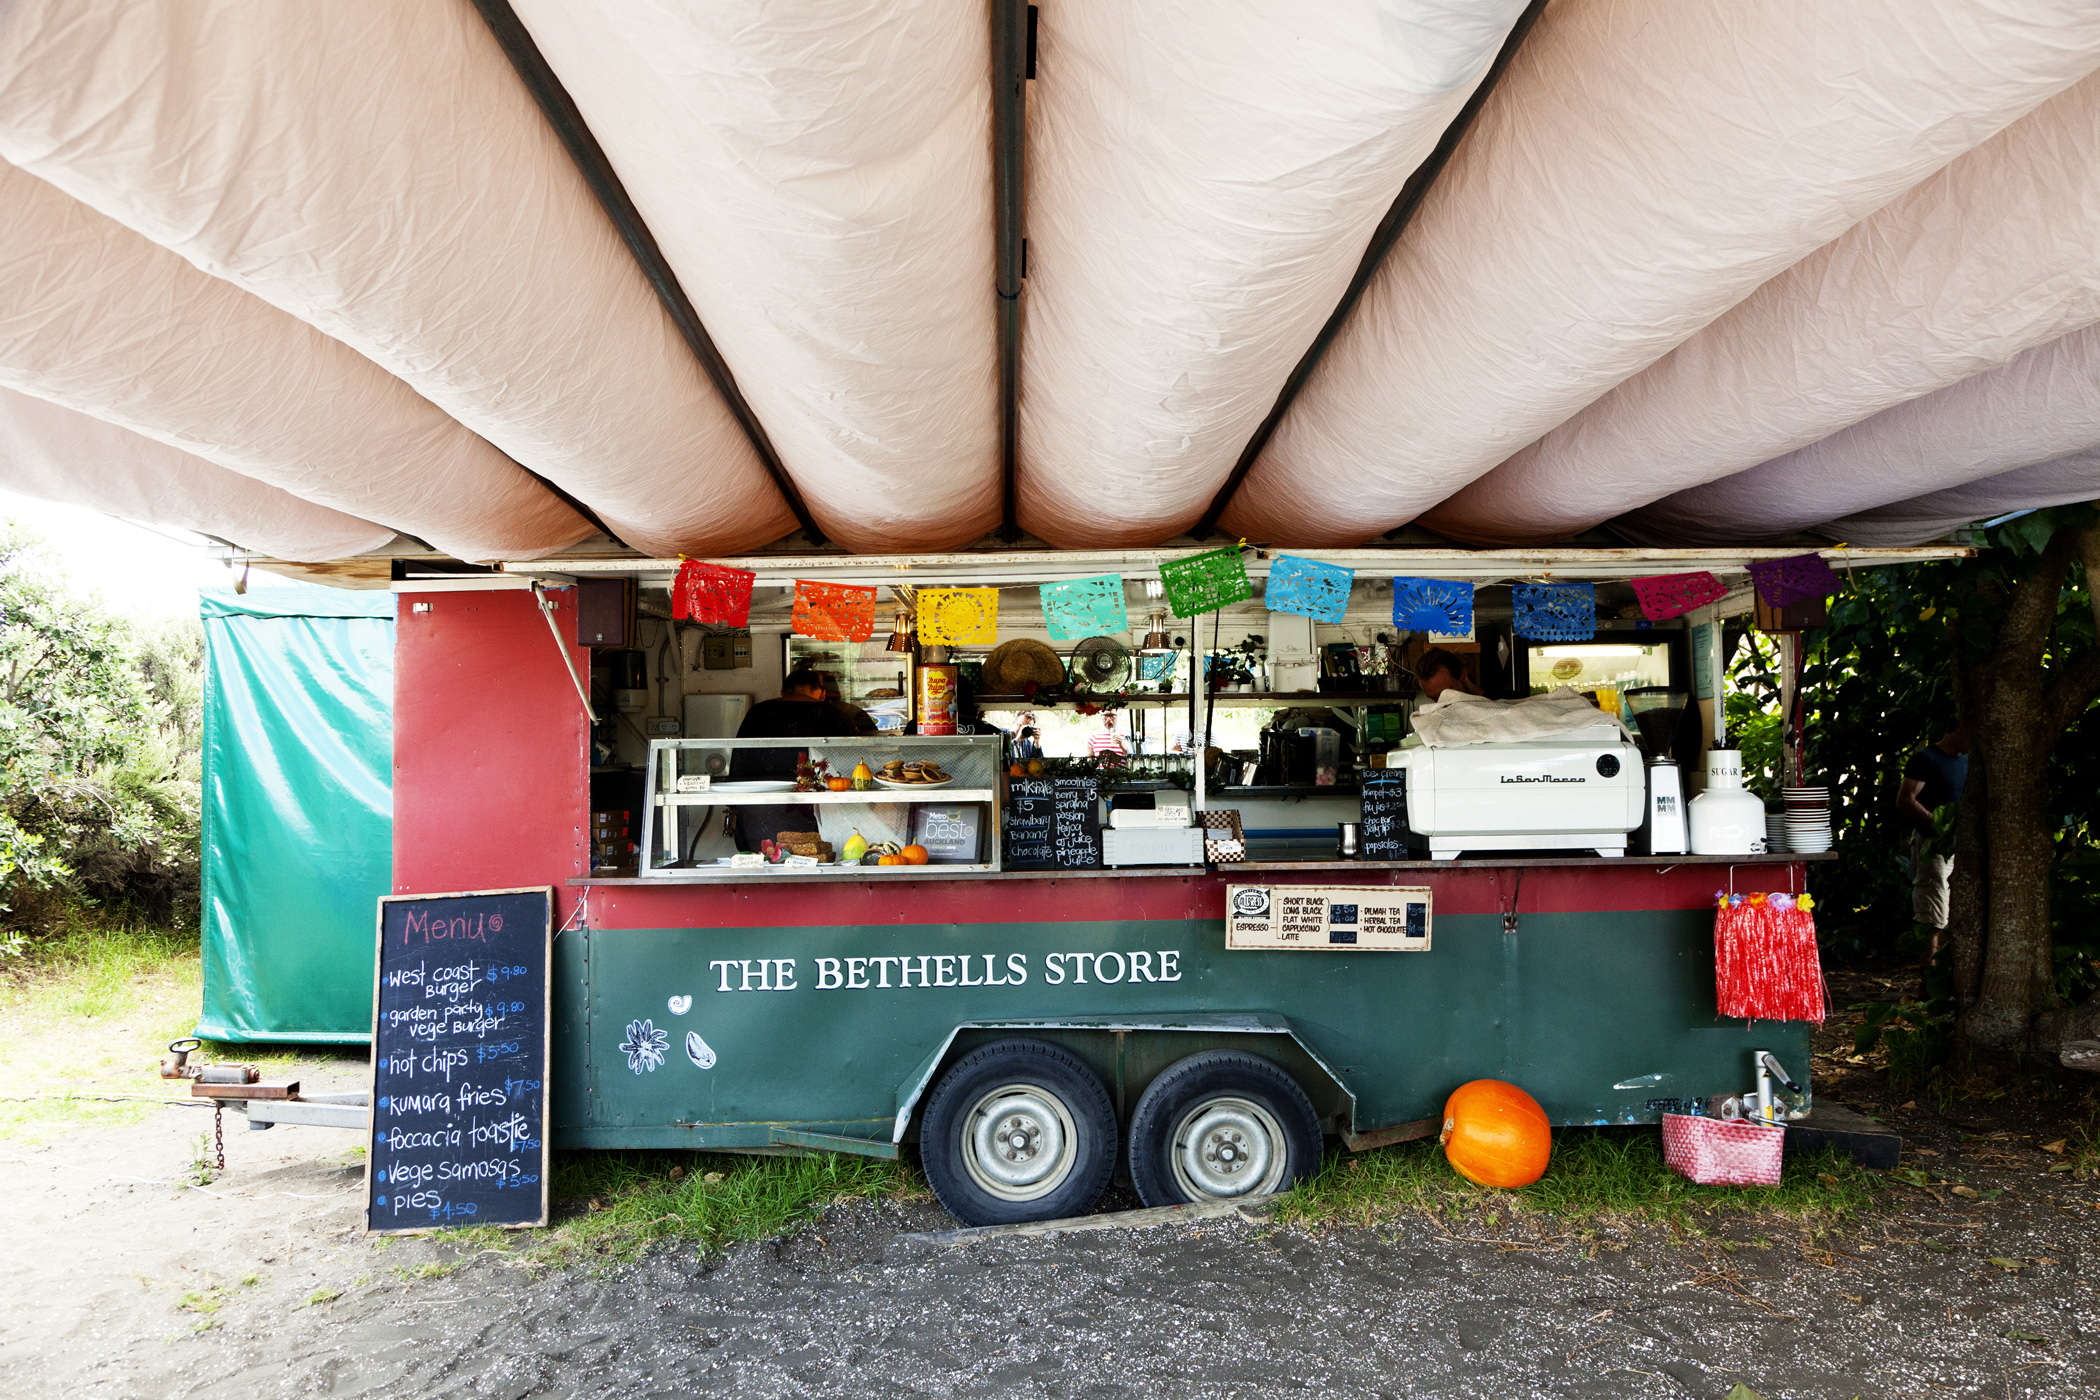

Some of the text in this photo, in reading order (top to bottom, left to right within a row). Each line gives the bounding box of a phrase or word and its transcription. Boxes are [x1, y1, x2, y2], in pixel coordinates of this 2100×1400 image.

[1711, 768, 1738, 776] SUGAR
[1055, 776, 1097, 787] smoothies
[1086, 789, 1097, 801] $5
[1017, 801, 1034, 814] $5
[929, 812, 947, 820] Metro
[925, 820, 966, 839] best
[1010, 831, 1048, 841] Banana
[924, 838, 966, 846] AUCKLAND
[1063, 855, 1096, 866] juice
[1283, 897, 1304, 905] SHORT
[1283, 907, 1322, 915] LONG BLACK
[1364, 907, 1387, 915] DILMAH
[1389, 907, 1400, 915] TEA
[1283, 916, 1323, 924] FLAT WHITE
[404, 910, 486, 945] Menu
[1236, 923, 1269, 932] ESPRESSO
[1282, 924, 1320, 932] CAPPUCCINO
[1282, 933, 1299, 941] LATTE
[433, 960, 480, 982] coast
[709, 950, 1183, 992] THE BETHELLS STORE
[389, 1005, 437, 1028] garden
[444, 1000, 483, 1023] party
[389, 1048, 417, 1078] hot
[422, 1045, 468, 1082] chips
[456, 1082, 507, 1111] fries
[385, 1111, 531, 1152] foccacia toastie
[393, 1190, 442, 1216] pies
